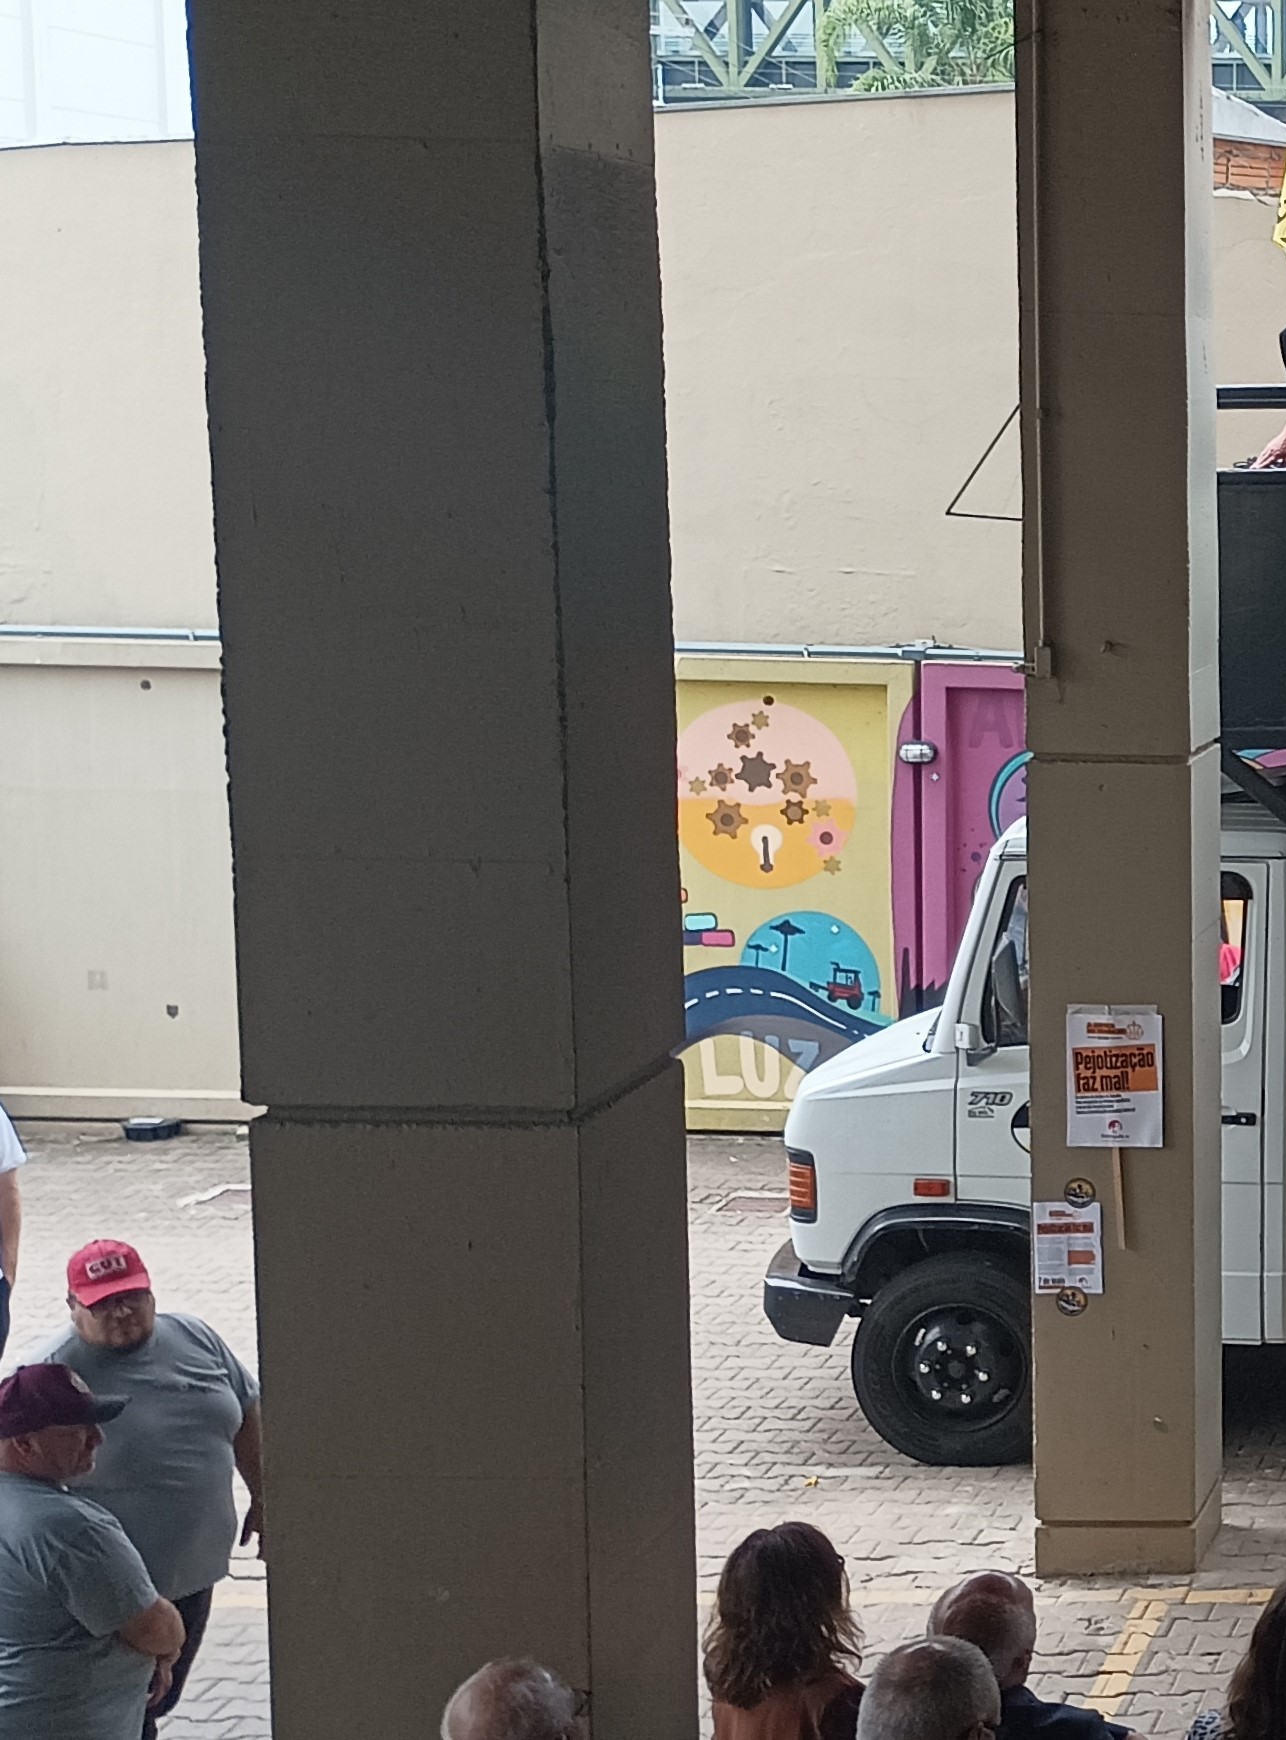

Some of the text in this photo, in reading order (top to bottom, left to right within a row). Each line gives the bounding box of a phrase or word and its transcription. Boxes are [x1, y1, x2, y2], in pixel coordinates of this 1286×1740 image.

[1074, 1047, 1155, 1072] Pejotização
[1075, 1072, 1099, 1093] faz
[968, 1091, 1013, 1106] 710
